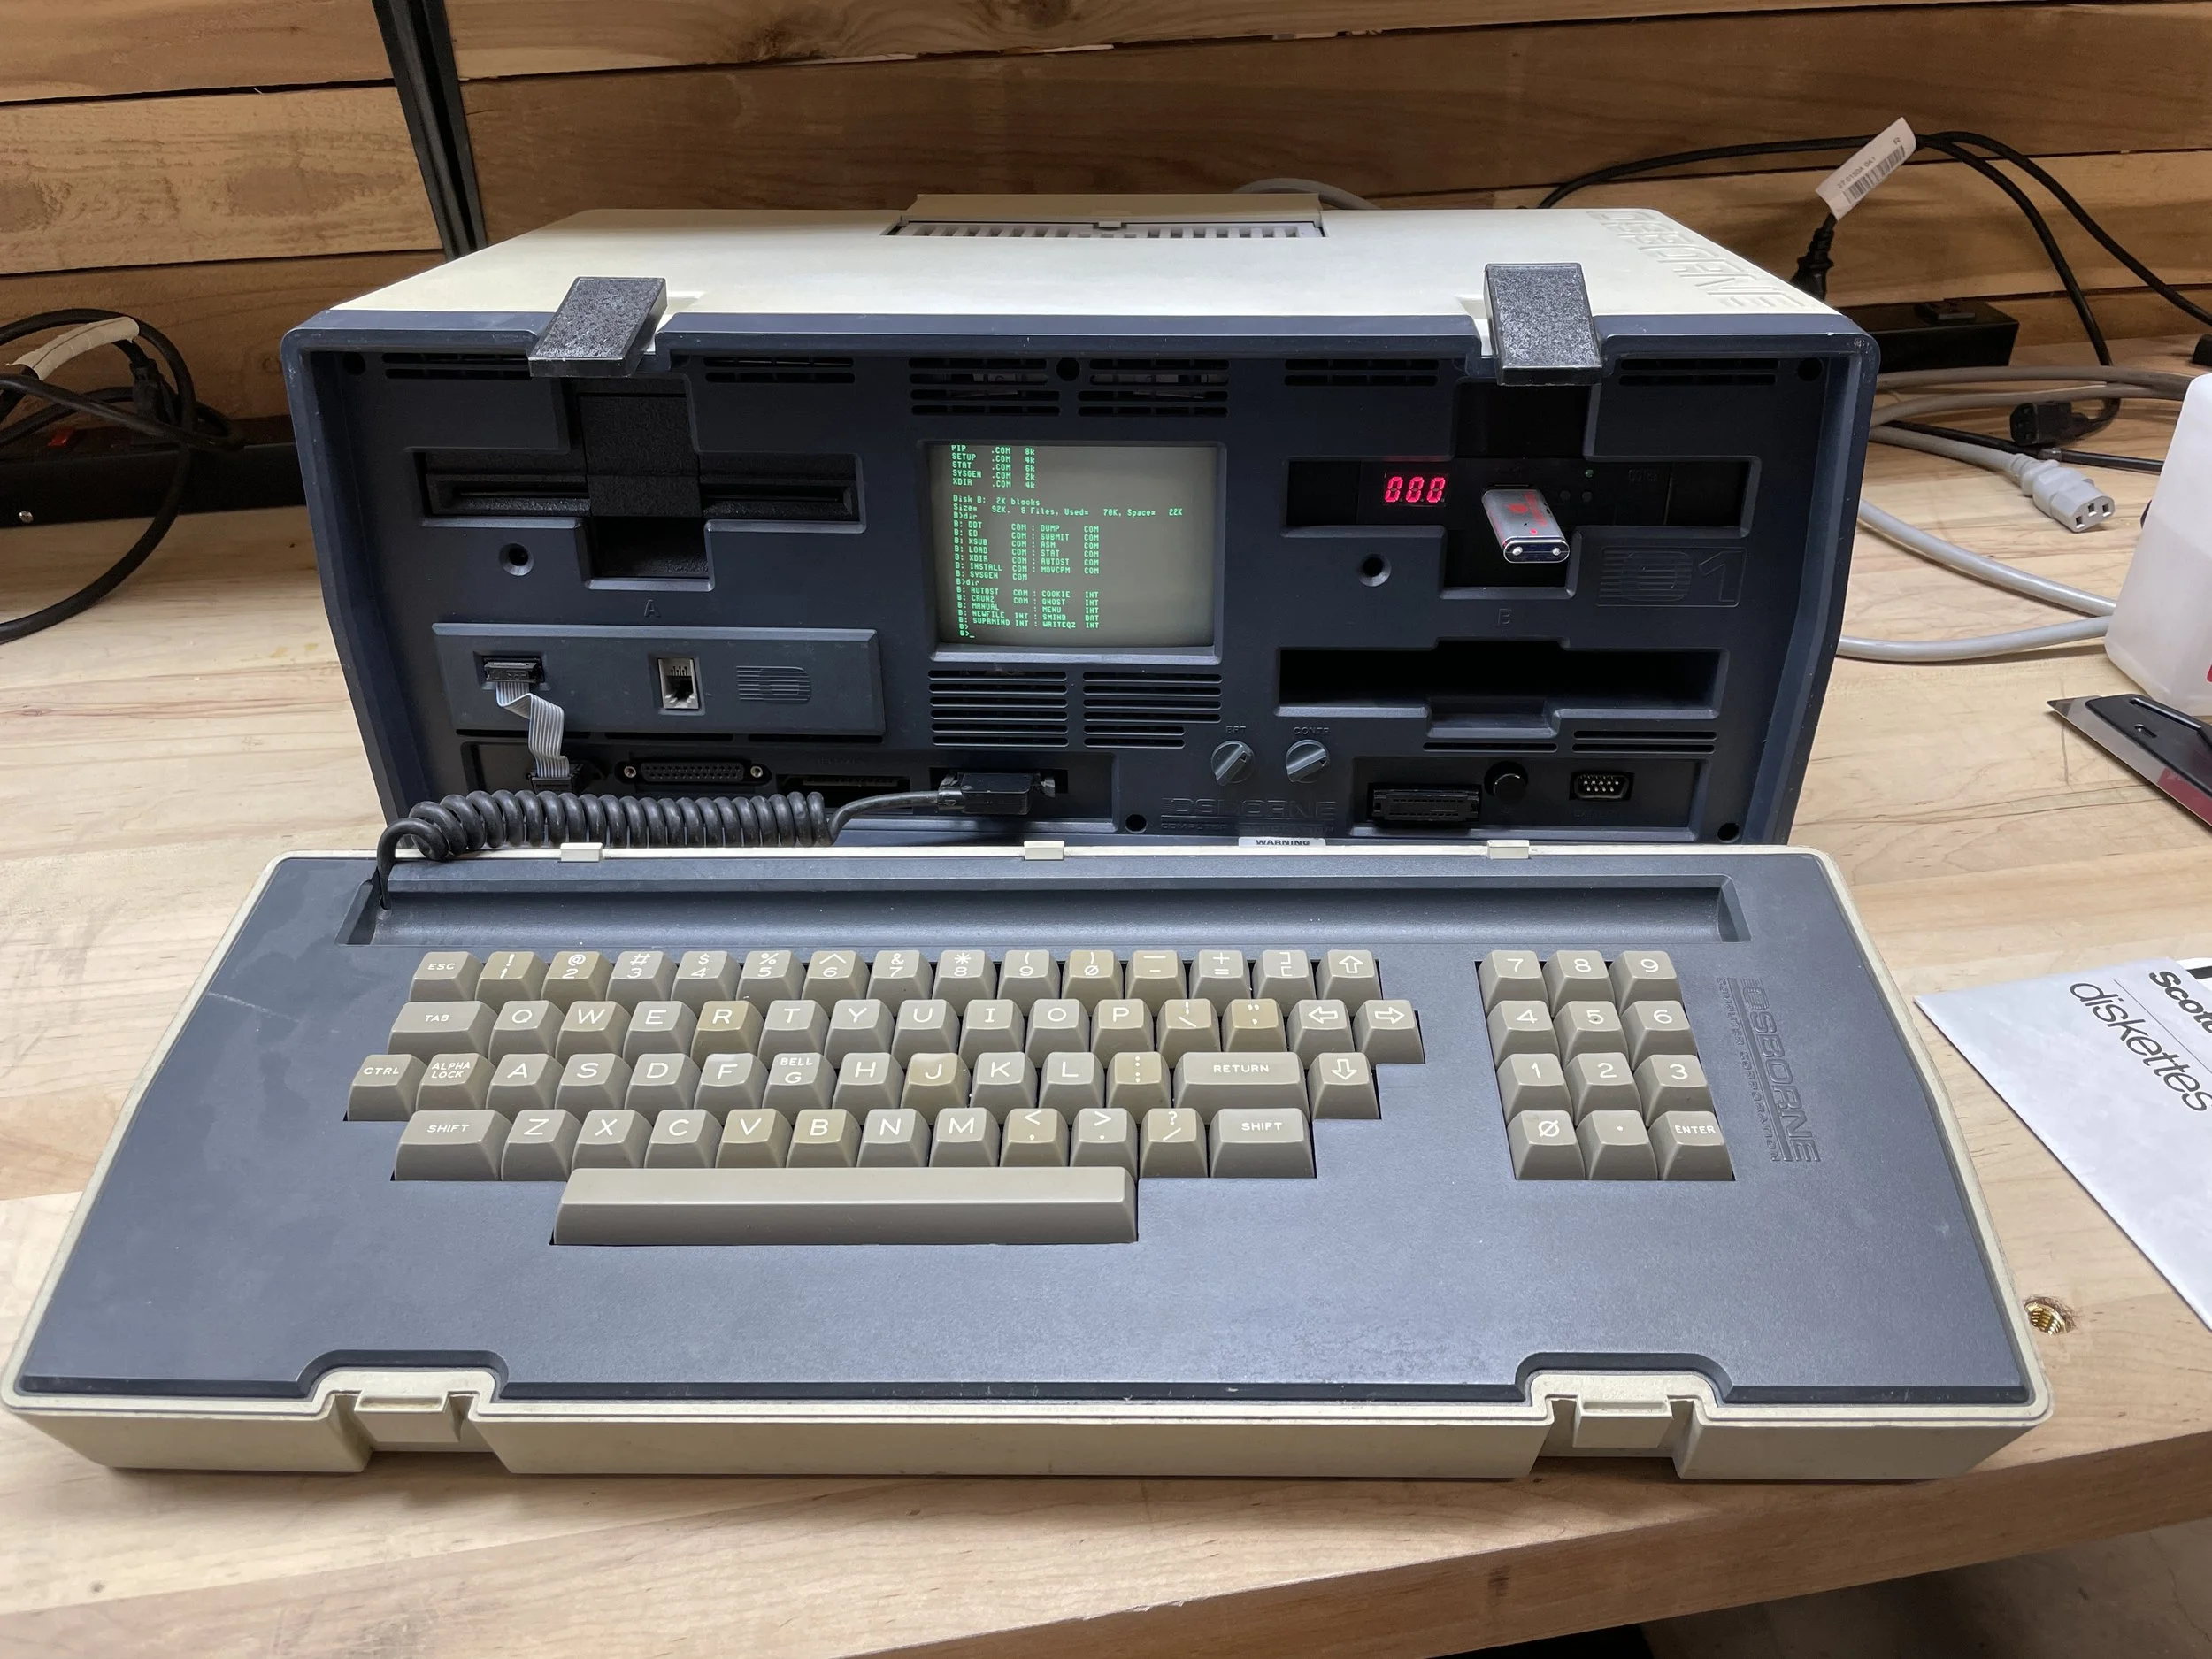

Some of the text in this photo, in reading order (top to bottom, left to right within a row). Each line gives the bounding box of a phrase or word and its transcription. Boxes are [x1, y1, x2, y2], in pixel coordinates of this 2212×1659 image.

[1385, 476, 1446, 503] 000
[1010, 498, 1040, 506] blocks
[691, 968, 706, 977] 4
[758, 967, 771, 977] 5
[824, 967, 837, 977] 6
[889, 968, 902, 977] 7
[955, 967, 967, 976] 8
[1020, 966, 1033, 976] 9
[1508, 959, 1523, 972] 7
[1575, 959, 1591, 972] 8
[1641, 959, 1658, 972] 9
[500, 968, 507, 979] 1
[563, 969, 578, 979] 2
[628, 969, 641, 978] 3
[512, 1010, 532, 1023] Q
[579, 1009, 605, 1023] W
[646, 1010, 666, 1024] E
[713, 1010, 732, 1023] R
[785, 1009, 800, 1023] T
[849, 1008, 866, 1022] Y
[914, 1008, 933, 1022] U
[985, 1008, 995, 1022] I
[1048, 1008, 1066, 1021] O
[1113, 1008, 1129, 1022] P
[1517, 1010, 1537, 1023] 4
[1587, 1010, 1603, 1024] 5
[1654, 1010, 1672, 1023] 6
[2069, 983, 2212, 1111] diskettes
[508, 1064, 527, 1078] A
[577, 1063, 598, 1078] S
[647, 1063, 668, 1078] D
[718, 1064, 737, 1079] F
[856, 1062, 876, 1077] H
[926, 1064, 941, 1079] J
[991, 1062, 1010, 1077] K
[1062, 1062, 1079, 1077] L
[1532, 1063, 1540, 1078] 1
[1598, 1063, 1617, 1078] 2
[1671, 1064, 1687, 1079] 3
[1740, 977, 1821, 1162] OSBORNE
[785, 1072, 801, 1083] G
[524, 1119, 549, 1134] Z
[595, 1119, 617, 1135] X
[669, 1119, 688, 1135] C
[741, 1118, 761, 1134] V
[810, 1119, 828, 1135] B
[880, 1118, 901, 1135] N
[949, 1118, 974, 1133] M
